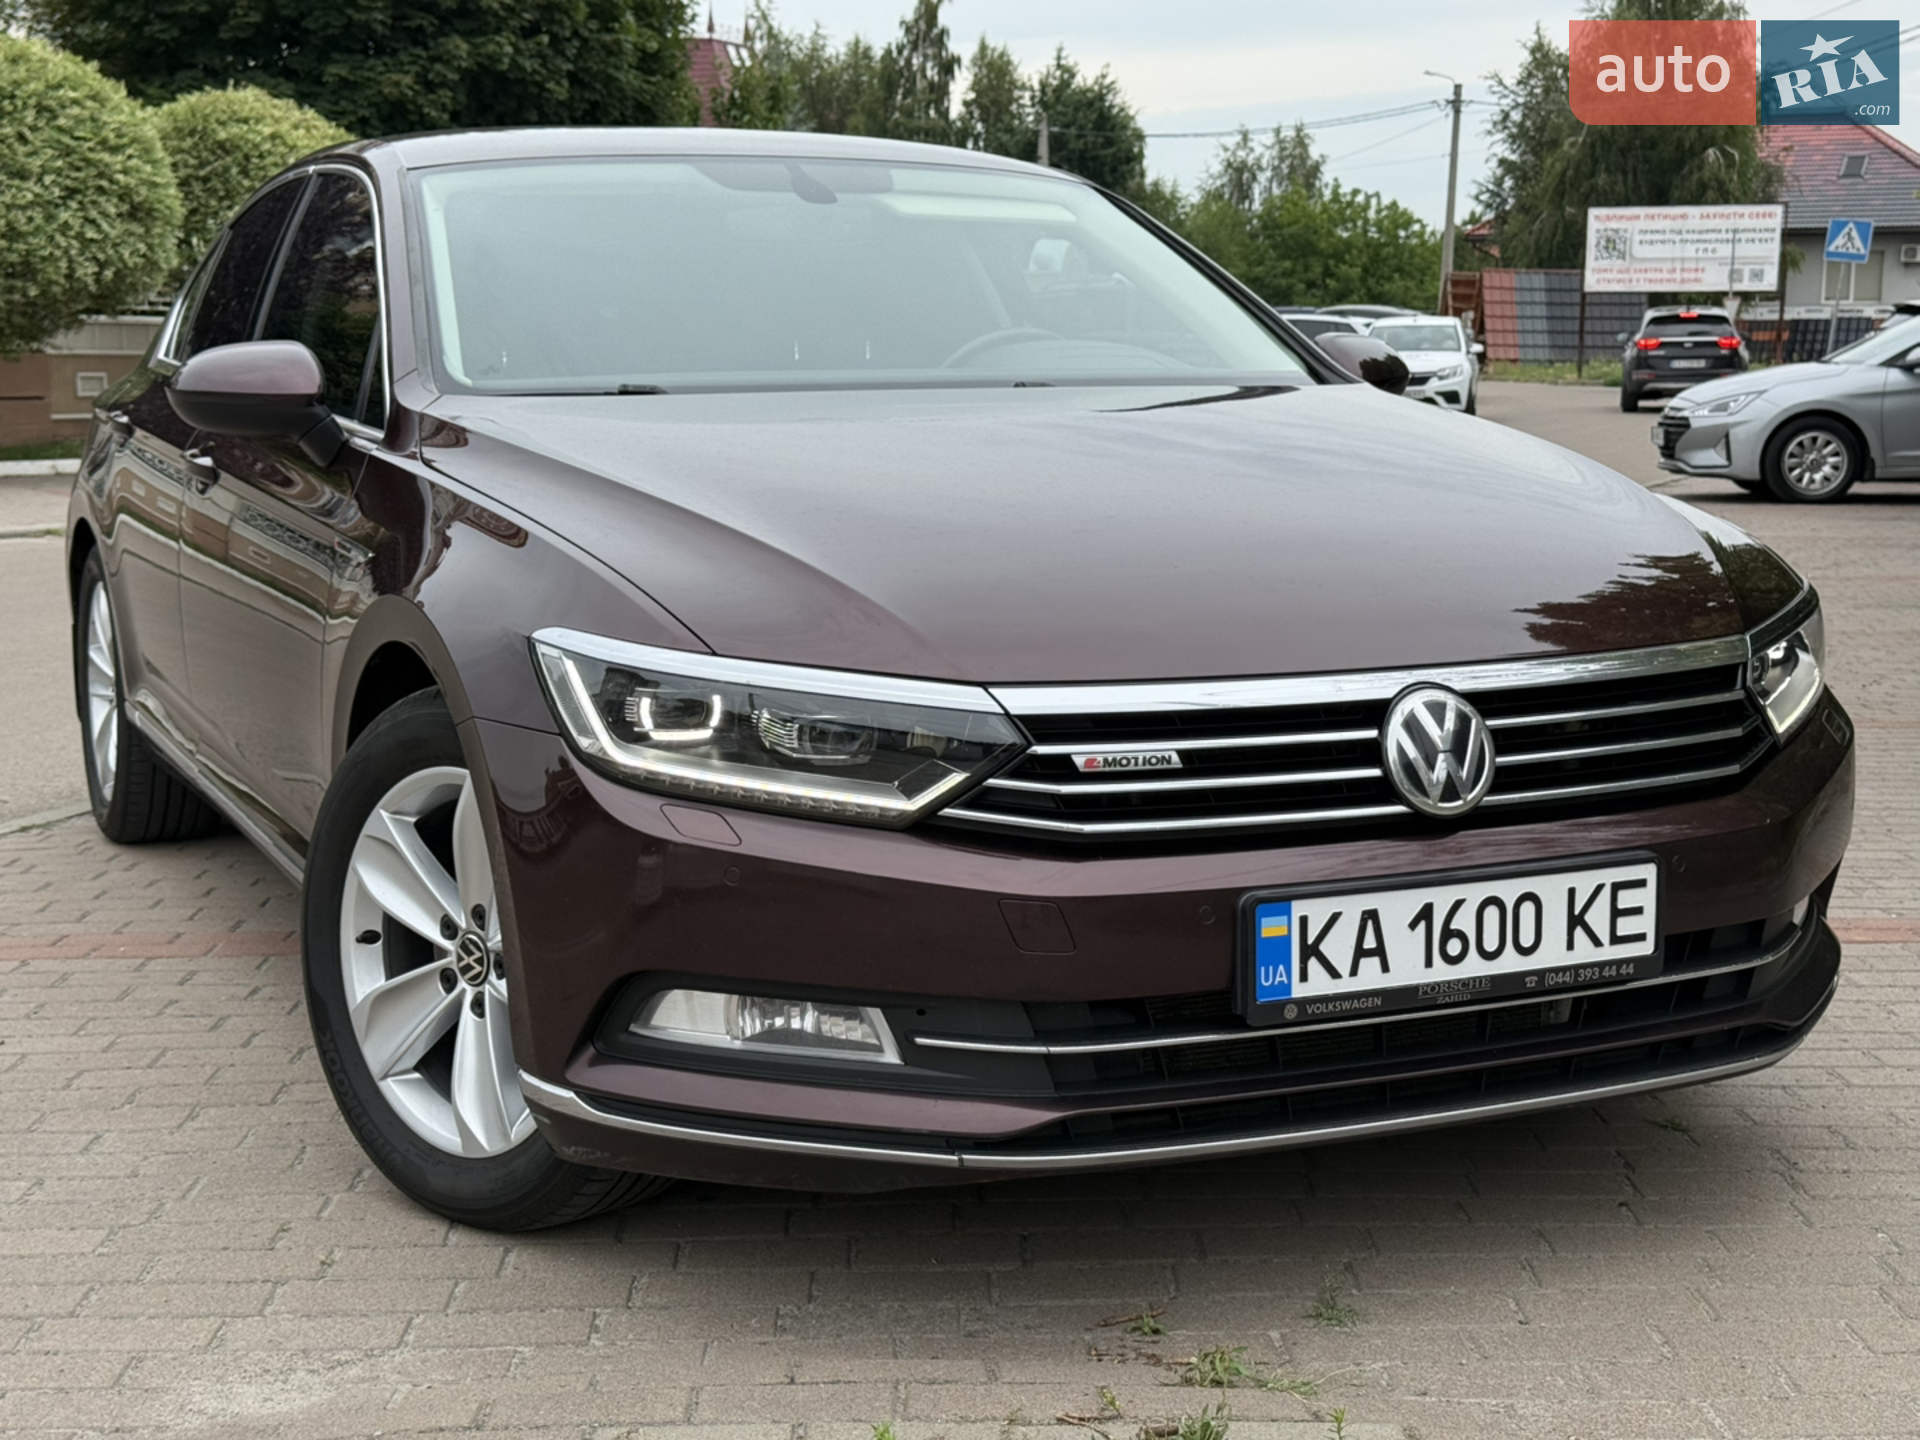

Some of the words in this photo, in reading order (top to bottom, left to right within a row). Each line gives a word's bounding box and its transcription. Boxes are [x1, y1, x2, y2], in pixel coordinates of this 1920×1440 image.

[1299, 908, 1391, 984] KA
[1407, 890, 1544, 970] 1600
[1565, 877, 1648, 952] KE
[1260, 964, 1289, 987] UA
[1544, 967, 1576, 988] (044)
[1577, 966, 1601, 984] 393
[1601, 964, 1619, 980] 44
[1619, 962, 1635, 977] 44
[1417, 976, 1492, 997] PORSCHE
[1305, 996, 1383, 1016] VOLKSWAGEN
[1436, 993, 1472, 1004] ZAHID
